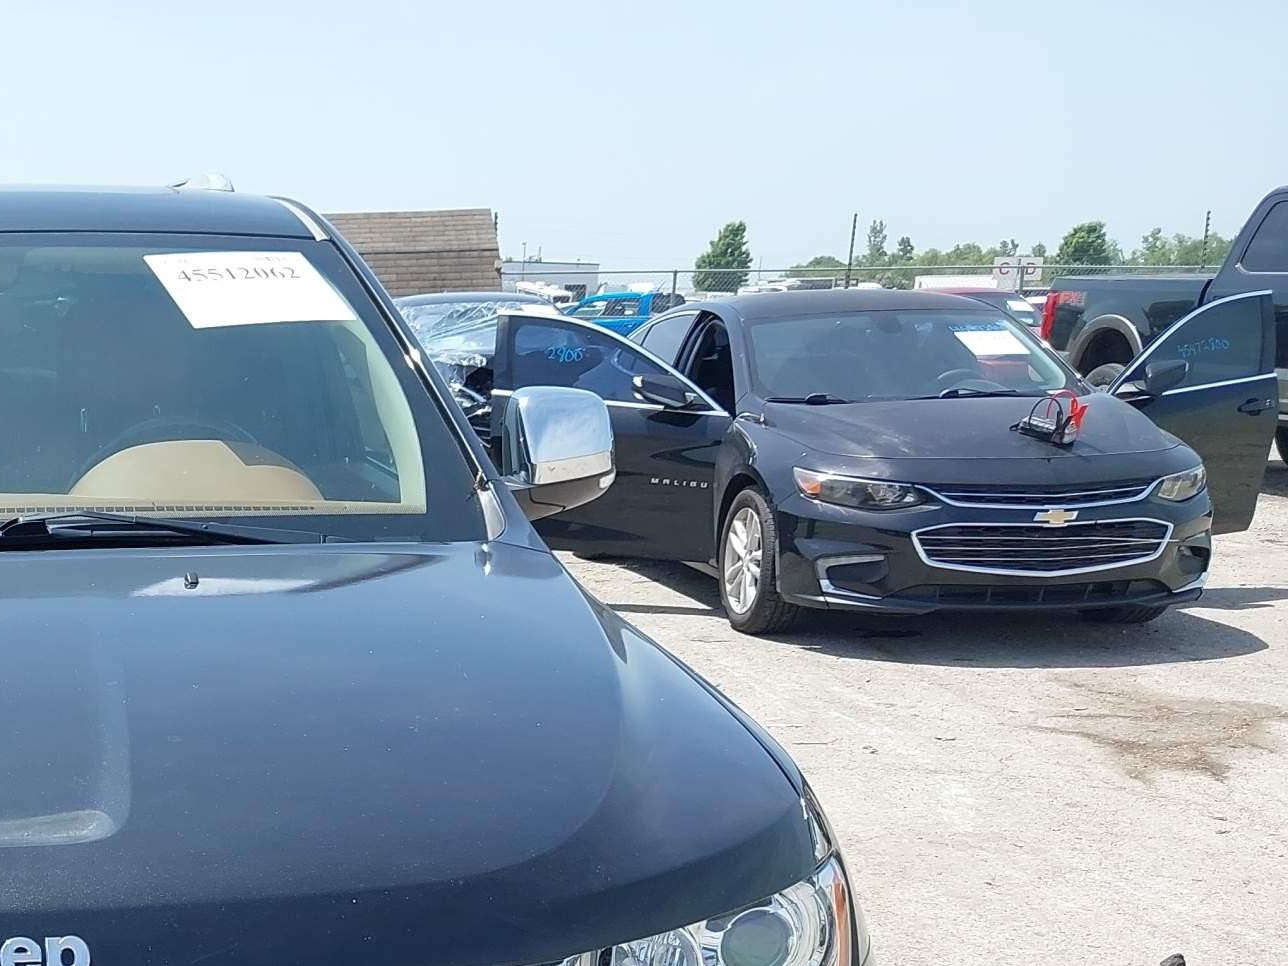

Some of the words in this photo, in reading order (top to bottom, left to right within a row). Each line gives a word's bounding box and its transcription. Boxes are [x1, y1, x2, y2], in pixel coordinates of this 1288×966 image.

[177, 266, 301, 283] 45512062
[998, 261, 1011, 276] C
[1024, 262, 1037, 276] D
[650, 477, 709, 489] MALIBU
